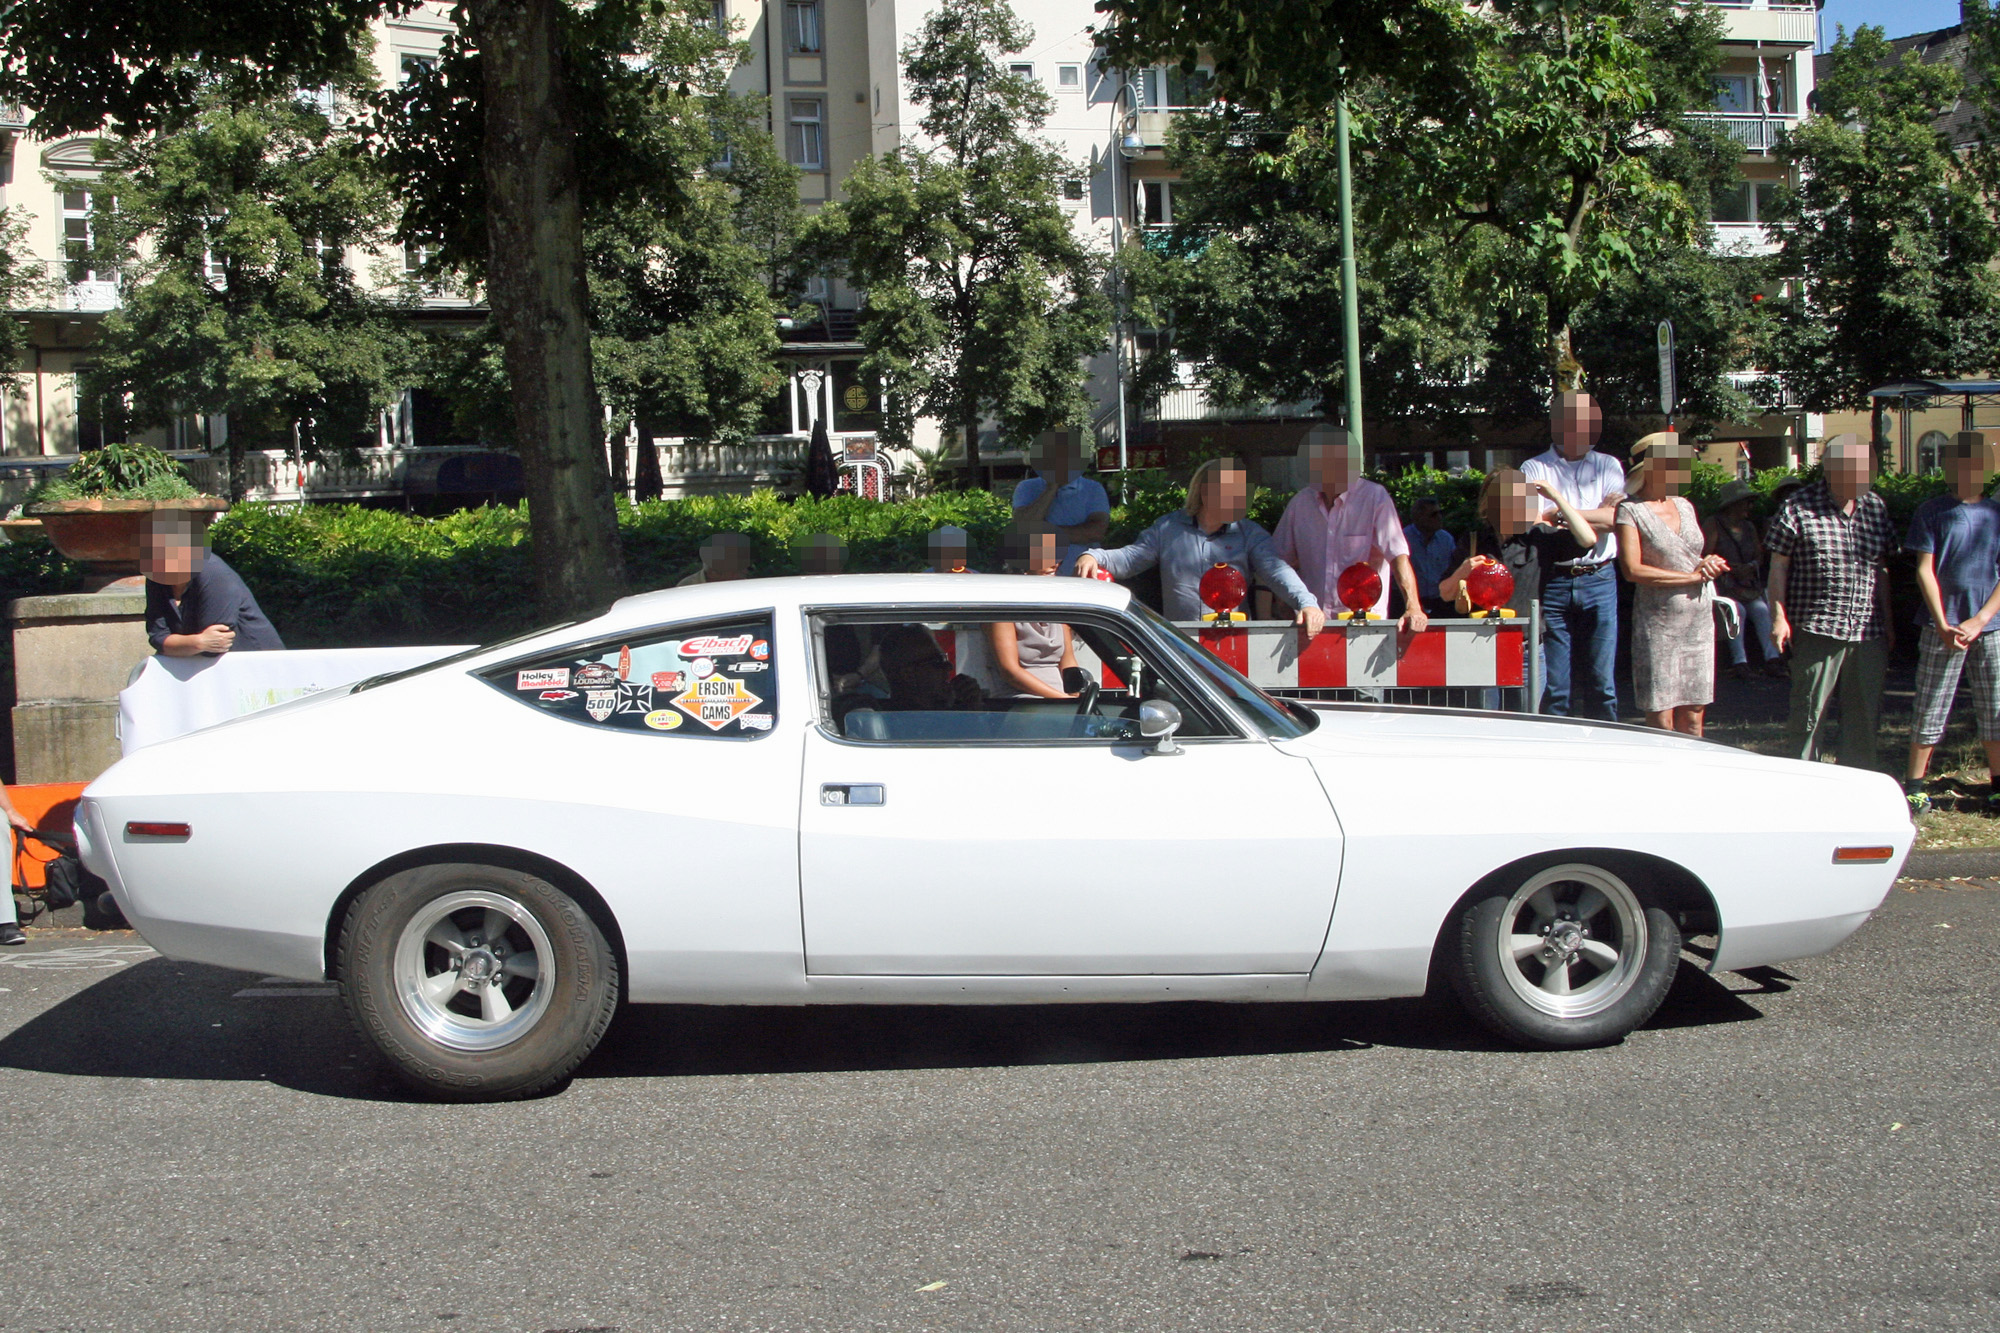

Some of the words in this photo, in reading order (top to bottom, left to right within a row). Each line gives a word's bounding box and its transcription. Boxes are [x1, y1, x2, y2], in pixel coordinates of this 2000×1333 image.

[680, 637, 750, 655] Eibach
[752, 643, 770, 657] 76
[694, 663, 712, 673] Esso
[521, 672, 553, 681] Holley
[521, 679, 566, 687] Manifolds
[698, 682, 735, 695] ERSON
[587, 699, 614, 709] 500
[702, 705, 730, 720] CAMS
[521, 873, 591, 1002] YOKOHAMA
[356, 974, 484, 1087] GEOLANDAR
